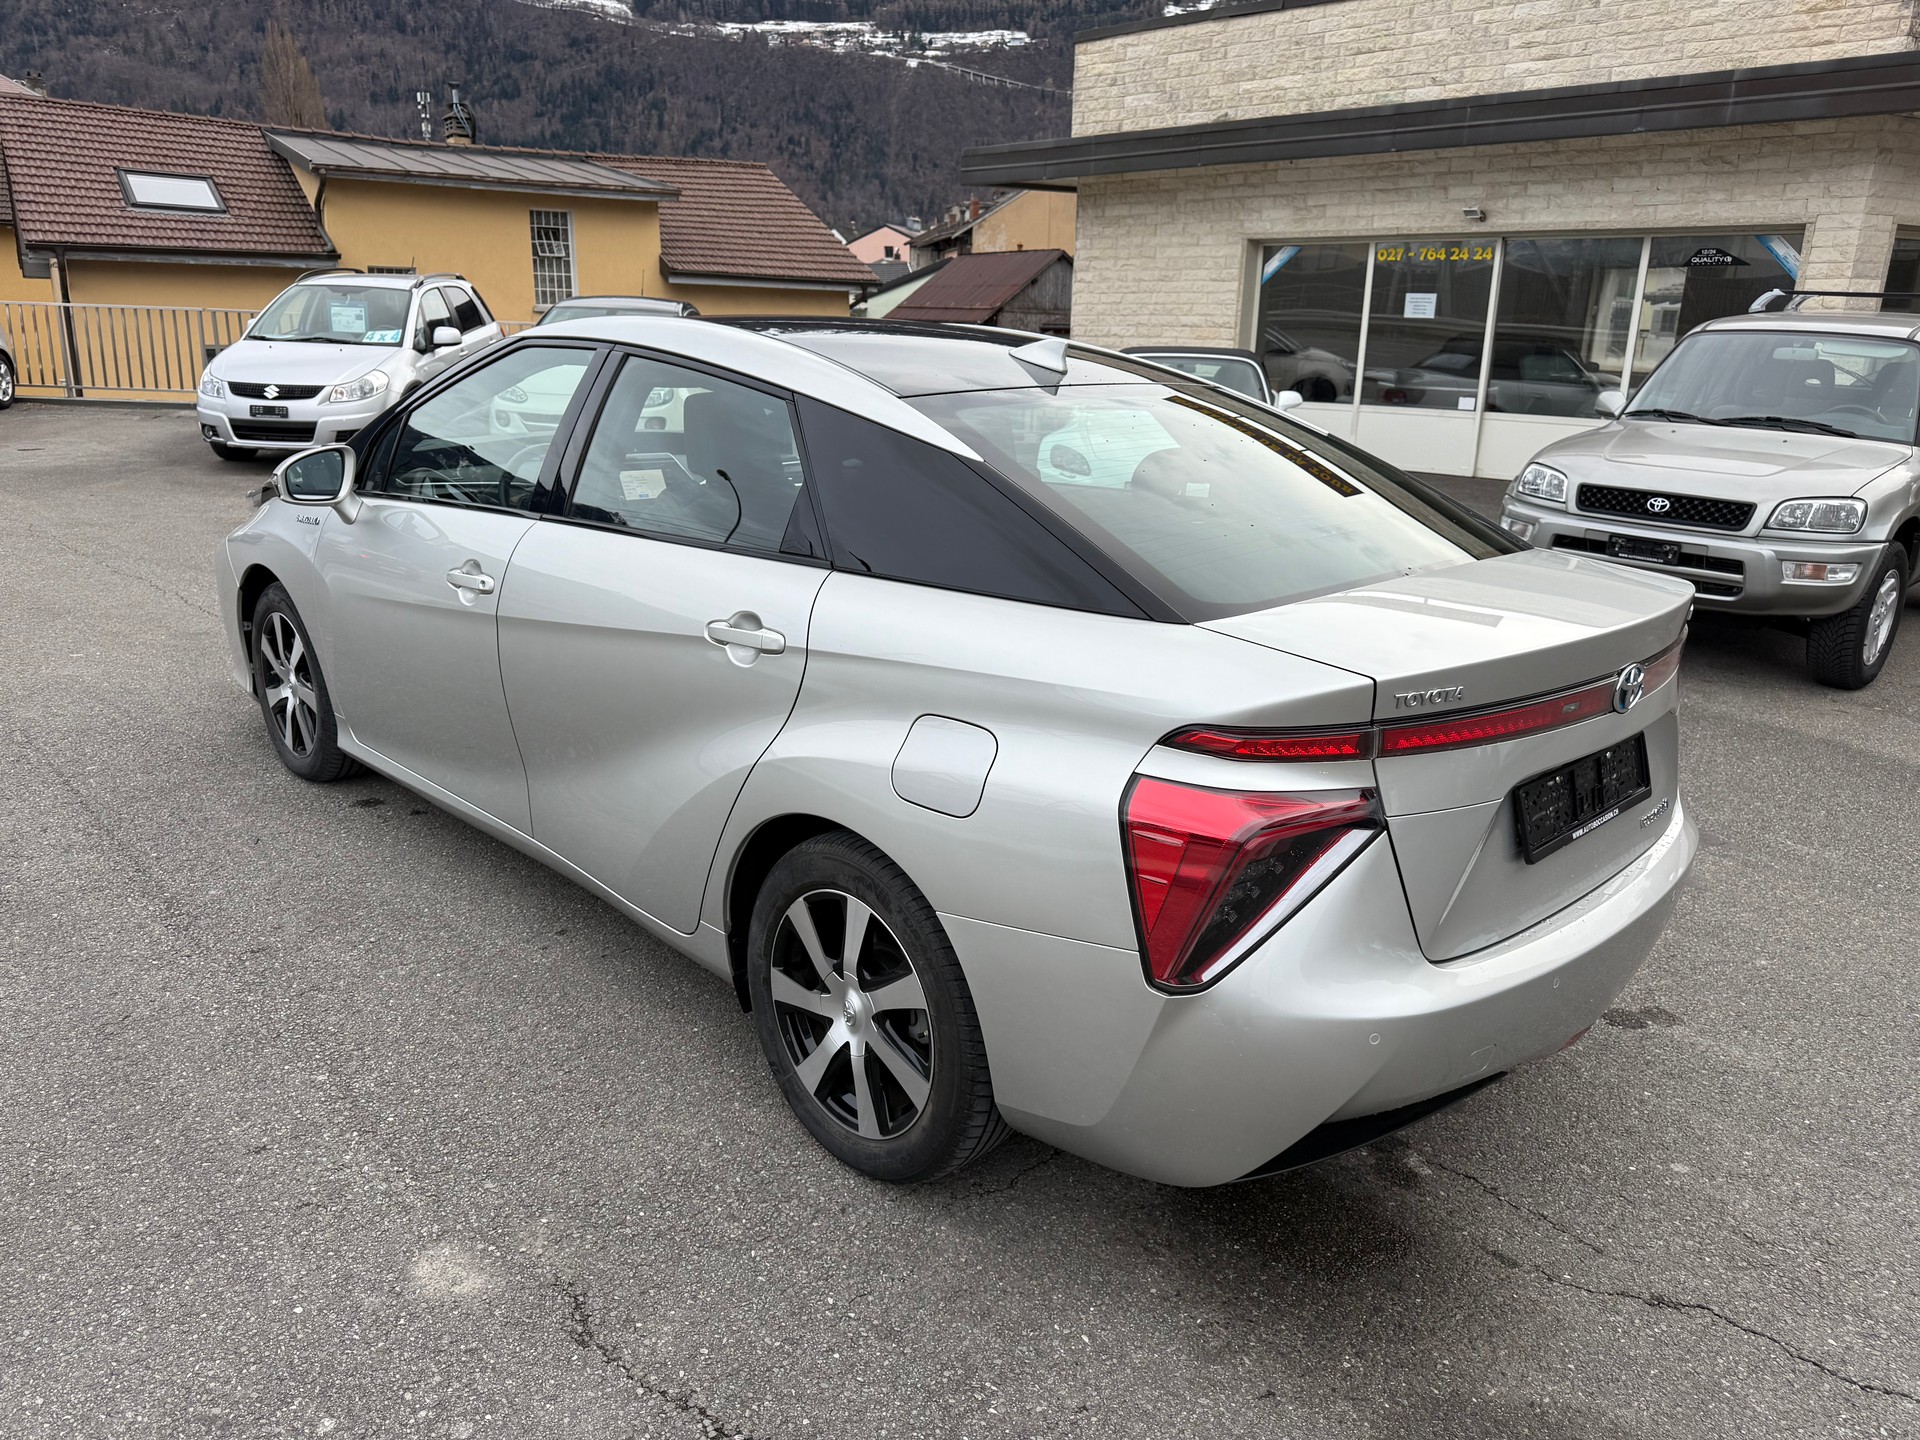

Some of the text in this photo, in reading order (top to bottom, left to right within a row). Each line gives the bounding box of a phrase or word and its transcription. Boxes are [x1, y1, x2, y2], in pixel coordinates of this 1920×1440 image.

[1377, 248, 1404, 261] 027
[1420, 248, 1446, 261] 764
[1450, 247, 1469, 260] 24
[1473, 247, 1492, 260] 24
[1393, 686, 1464, 709] TOYOTA
